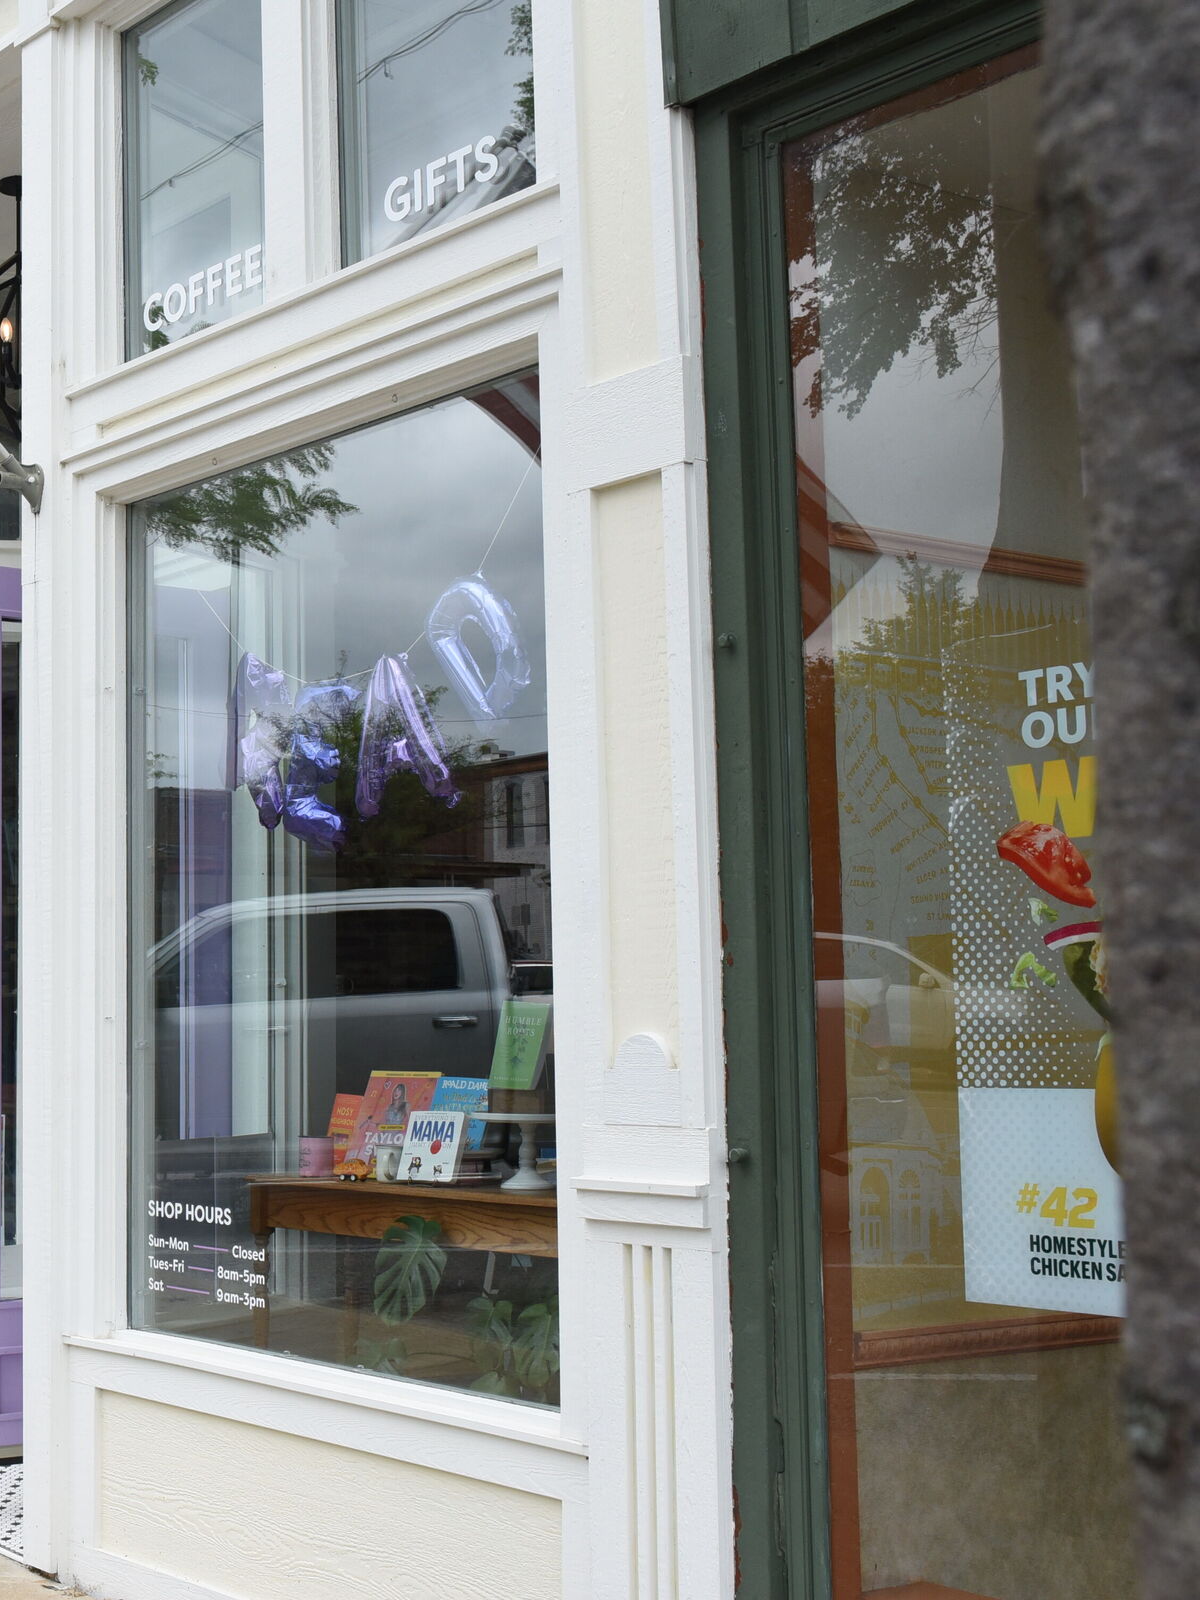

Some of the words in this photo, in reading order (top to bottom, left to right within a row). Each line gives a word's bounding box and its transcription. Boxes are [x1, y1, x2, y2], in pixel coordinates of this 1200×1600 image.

[384, 135, 499, 223] GIFTS
[143, 243, 263, 333] COFFEE
[1017, 662, 1095, 707] TRY
[1021, 704, 1097, 749] OU
[504, 1015, 543, 1026] HUMBLE
[442, 1079, 467, 1089] ROALD
[364, 1131, 404, 1144] TAYLO
[410, 1121, 455, 1143] MAMA
[148, 1200, 183, 1219] SHOP
[185, 1204, 232, 1225] HOURS
[1016, 1183, 1098, 1229] #42
[148, 1234, 189, 1251] Sun-Mon
[232, 1245, 265, 1261] Closed
[148, 1256, 185, 1273] Tues-Fri
[217, 1266, 265, 1286] 8am-5pm
[1030, 1257, 1103, 1281] CHICKEN
[148, 1277, 164, 1291] Sat
[216, 1289, 265, 1309] 9am-3pm
